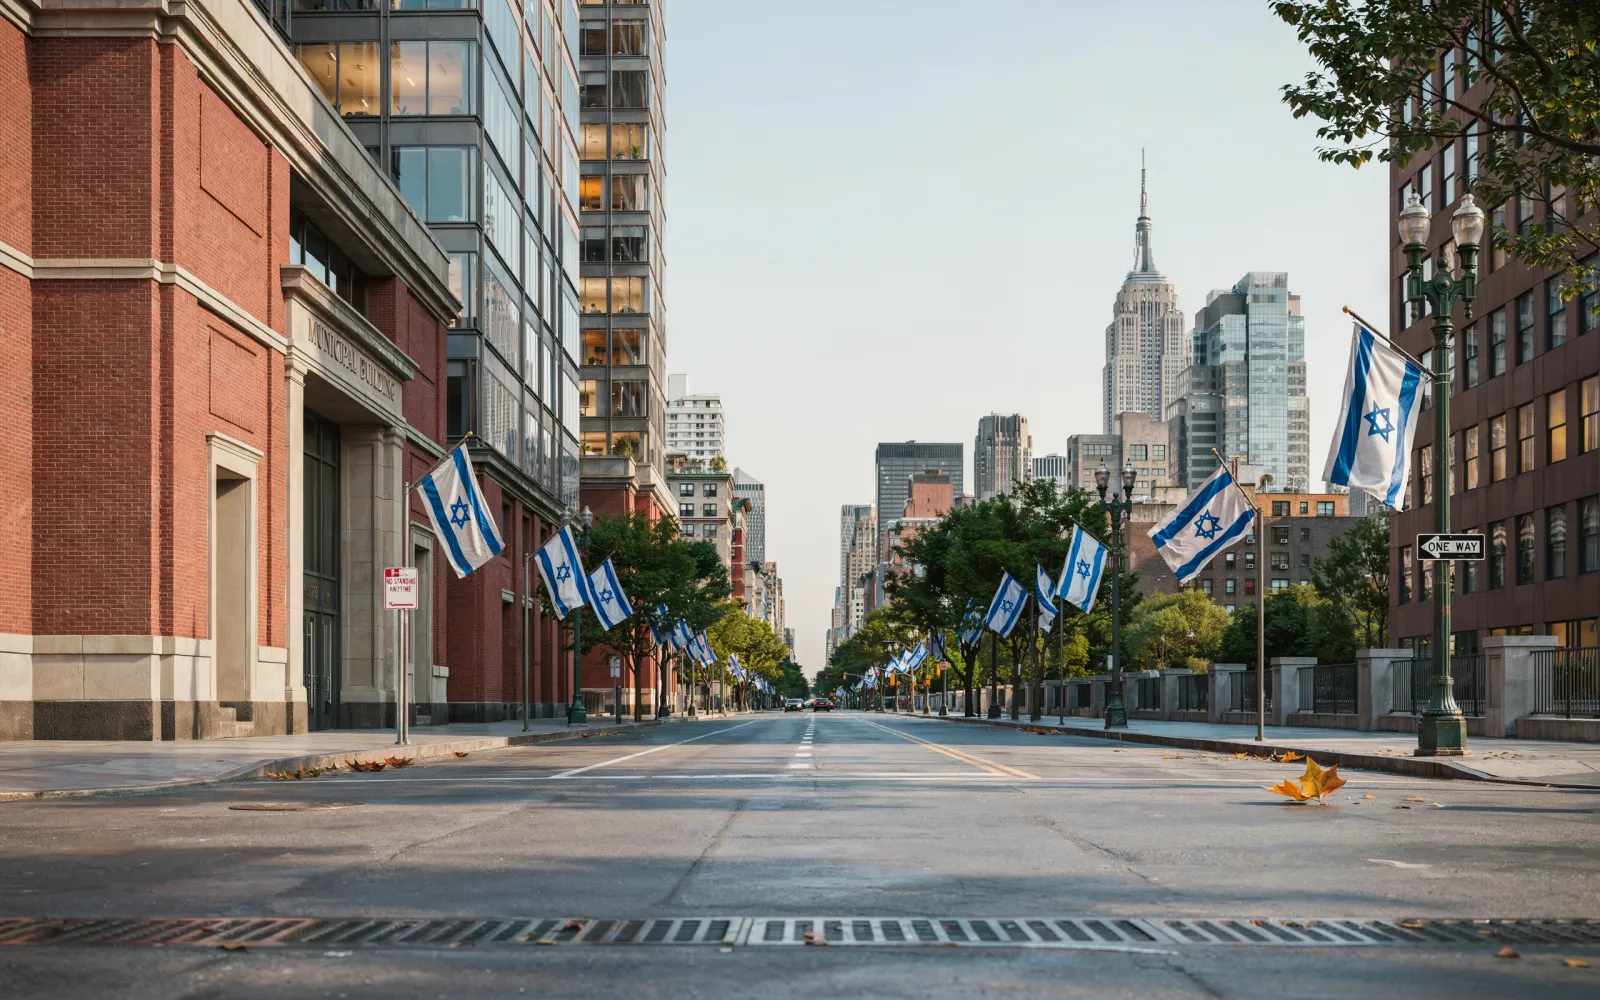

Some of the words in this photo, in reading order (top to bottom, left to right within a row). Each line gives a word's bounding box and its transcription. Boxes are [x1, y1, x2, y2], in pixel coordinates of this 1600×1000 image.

[308, 318, 357, 374] MUNICIPAL
[360, 357, 395, 402] BUILDING
[1428, 541, 1450, 552] ONE
[1455, 541, 1478, 552] WAY
[394, 577, 416, 585] STANDING
